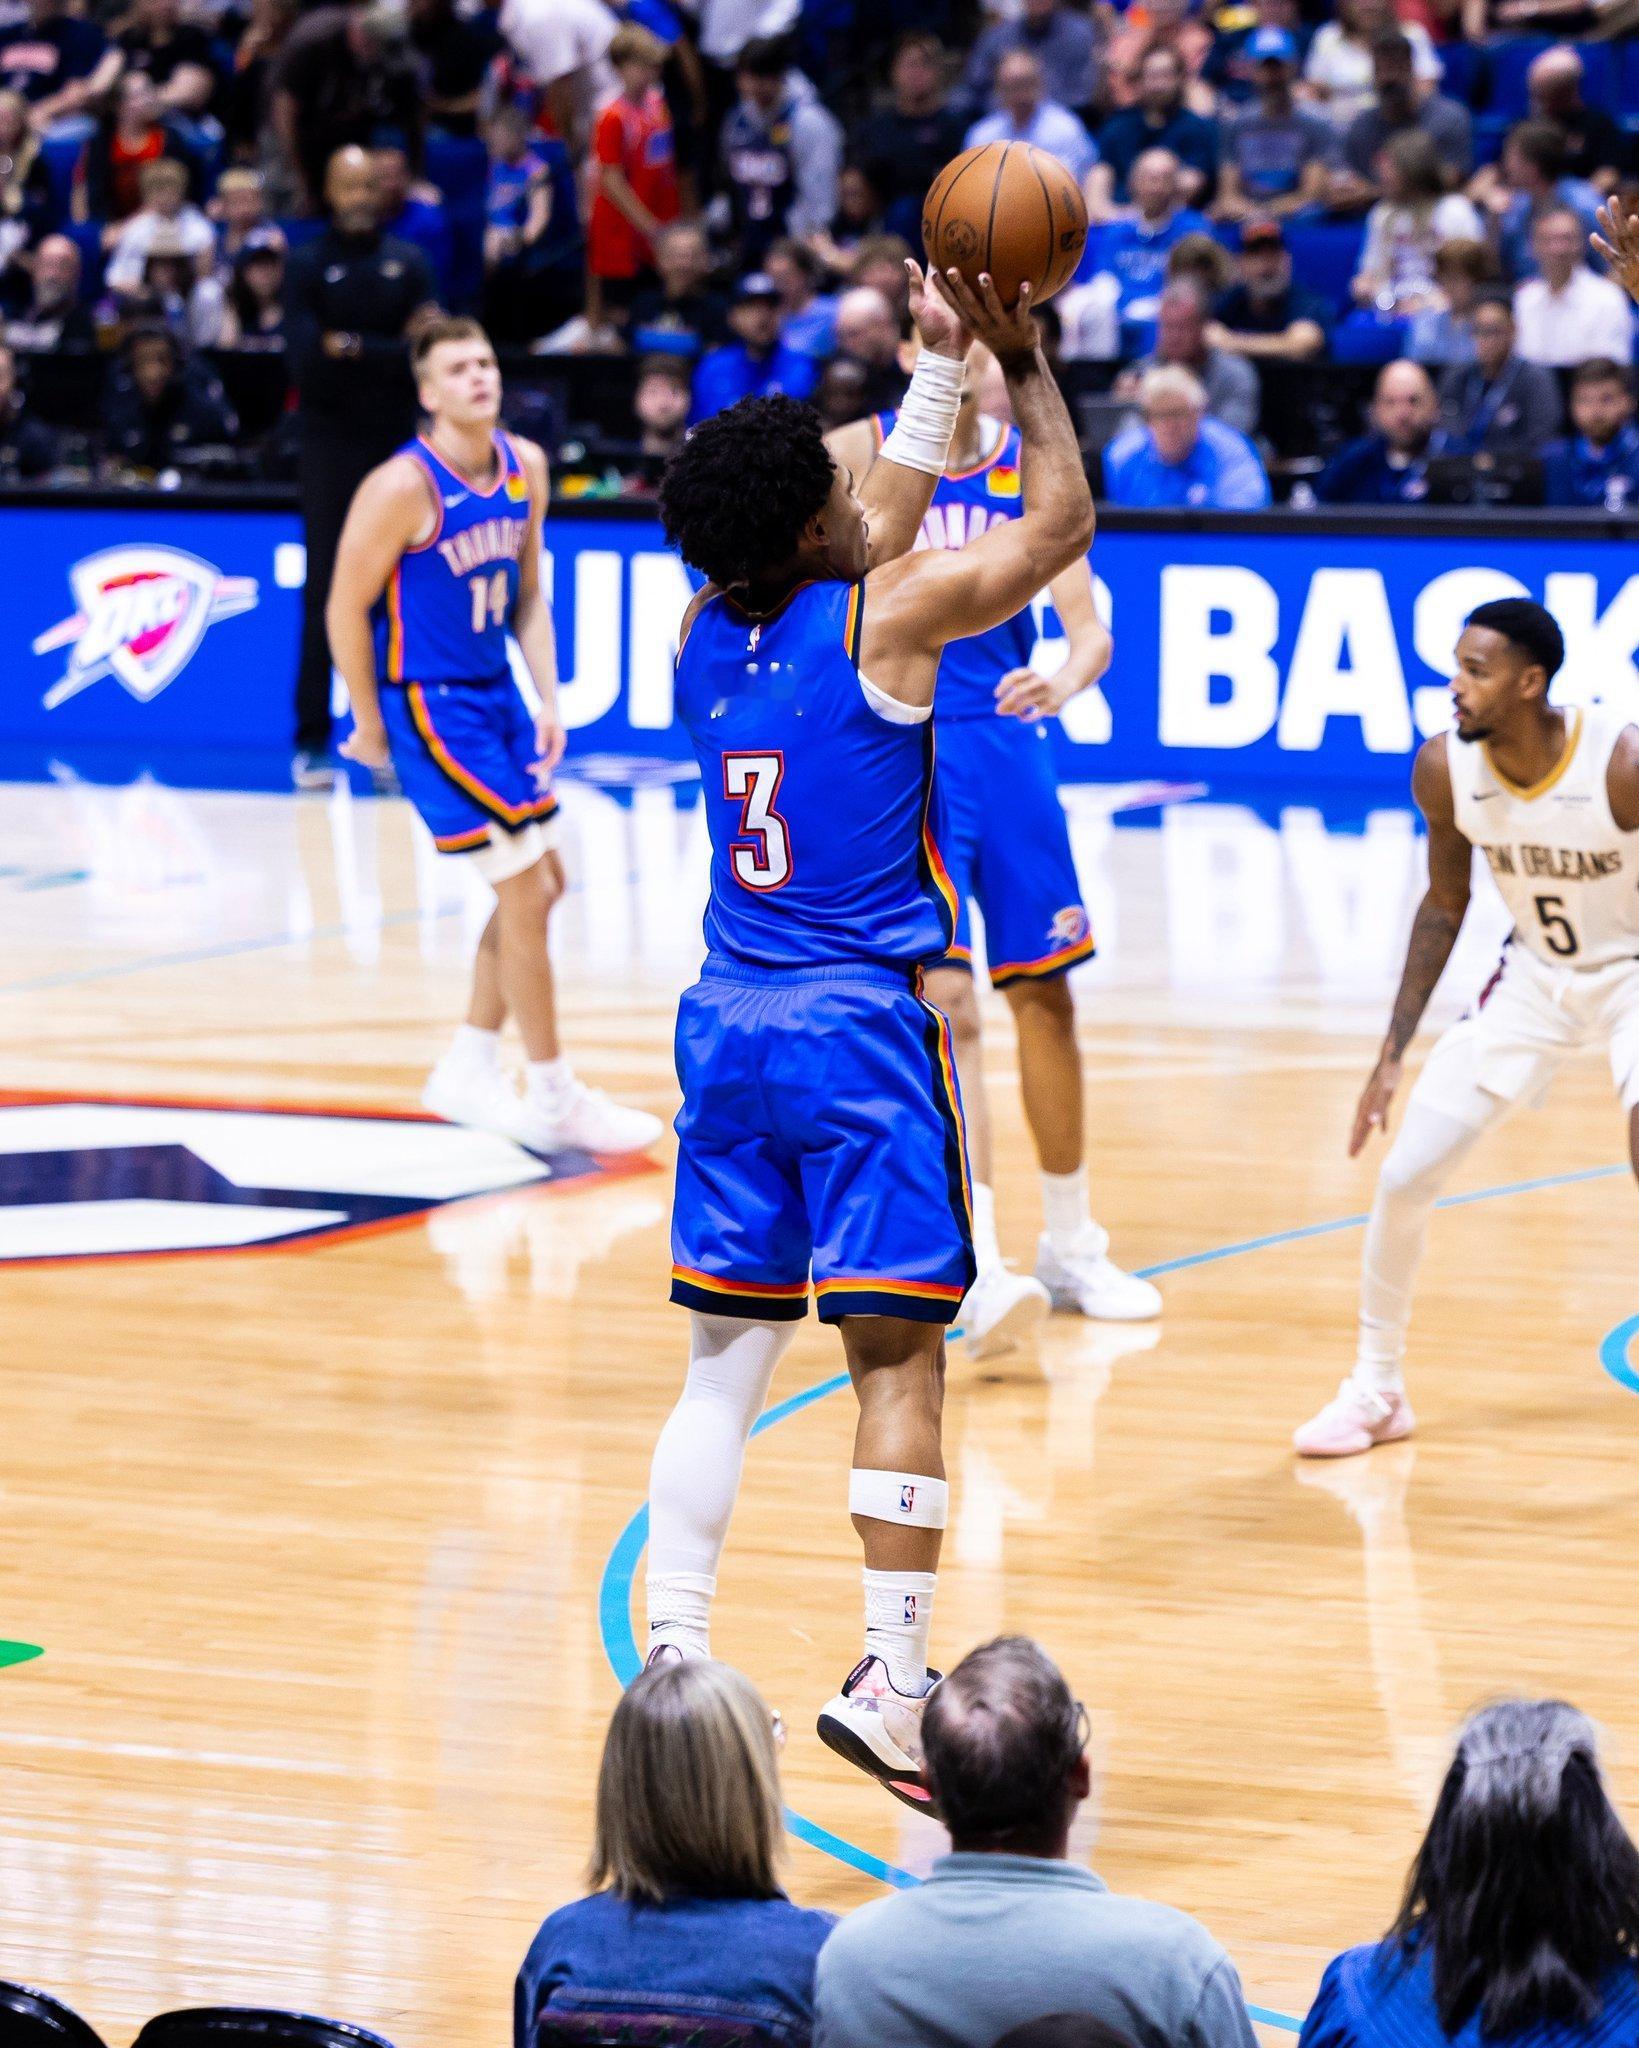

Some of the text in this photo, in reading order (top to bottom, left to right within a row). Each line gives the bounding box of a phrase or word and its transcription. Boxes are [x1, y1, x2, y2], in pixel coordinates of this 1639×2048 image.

[468, 569, 509, 634] 14
[721, 750, 793, 893] 3
[1520, 843, 1623, 881] ORLEANS
[1534, 894, 1579, 957] 5
